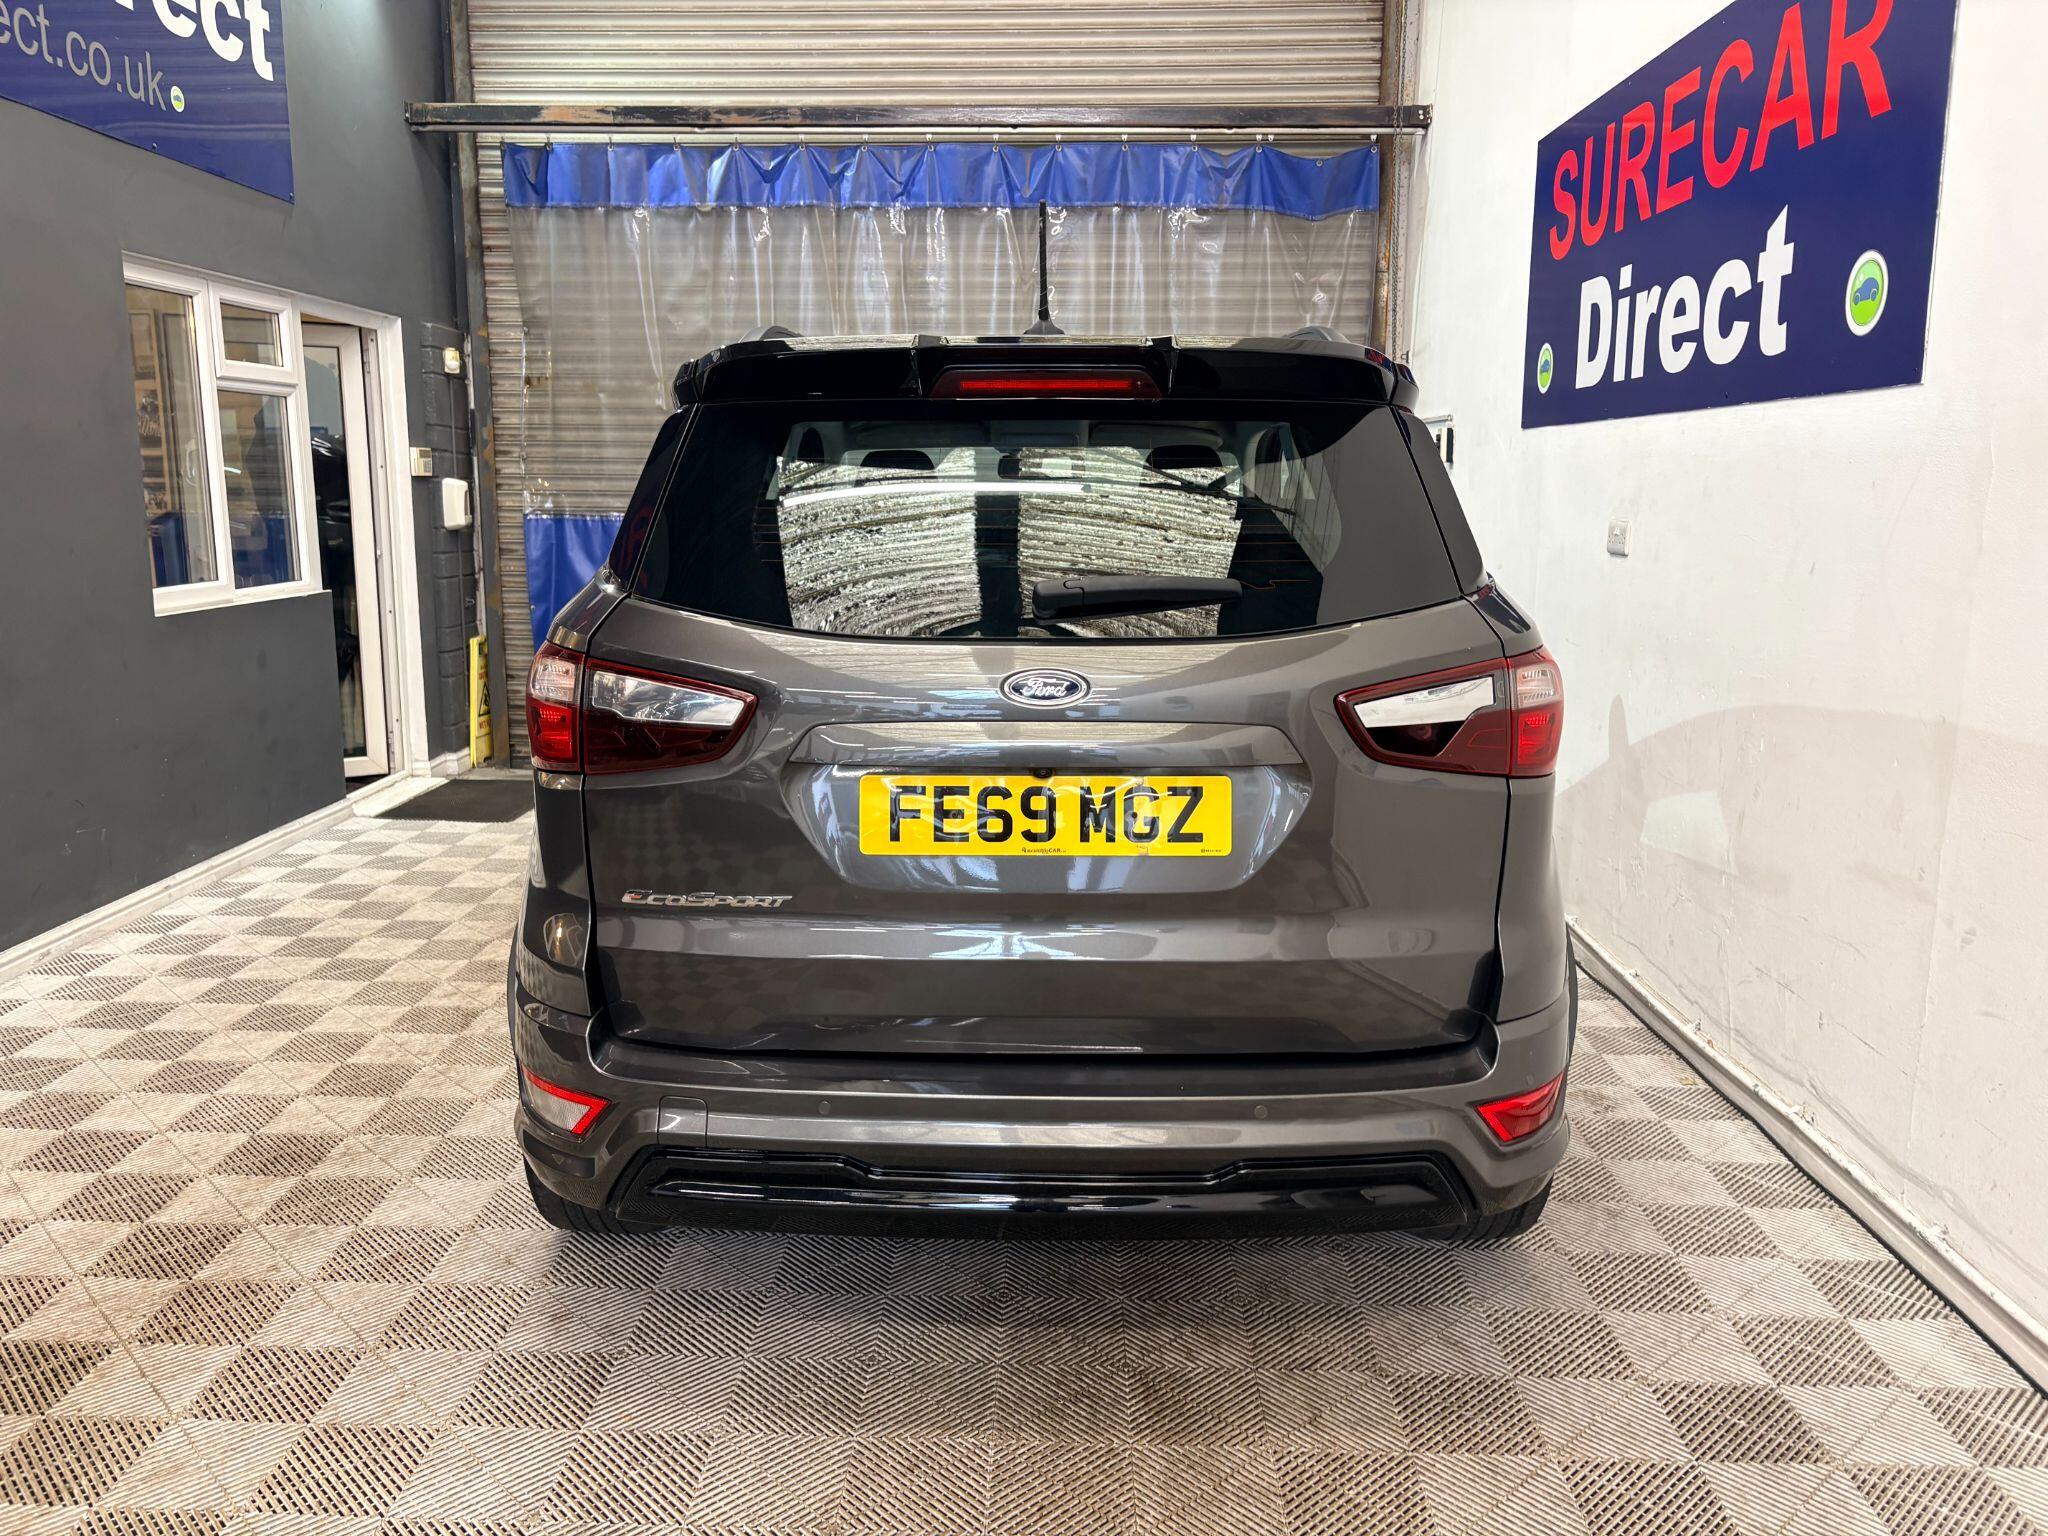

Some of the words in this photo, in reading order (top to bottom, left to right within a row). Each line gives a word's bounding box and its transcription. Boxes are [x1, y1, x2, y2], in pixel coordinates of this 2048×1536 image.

[1549, 0, 1892, 260] SURECAR
[1575, 204, 1795, 390] Direct
[1019, 677, 1070, 698] Ford
[888, 785, 1057, 843] FE69
[1079, 785, 1204, 843] MGZ
